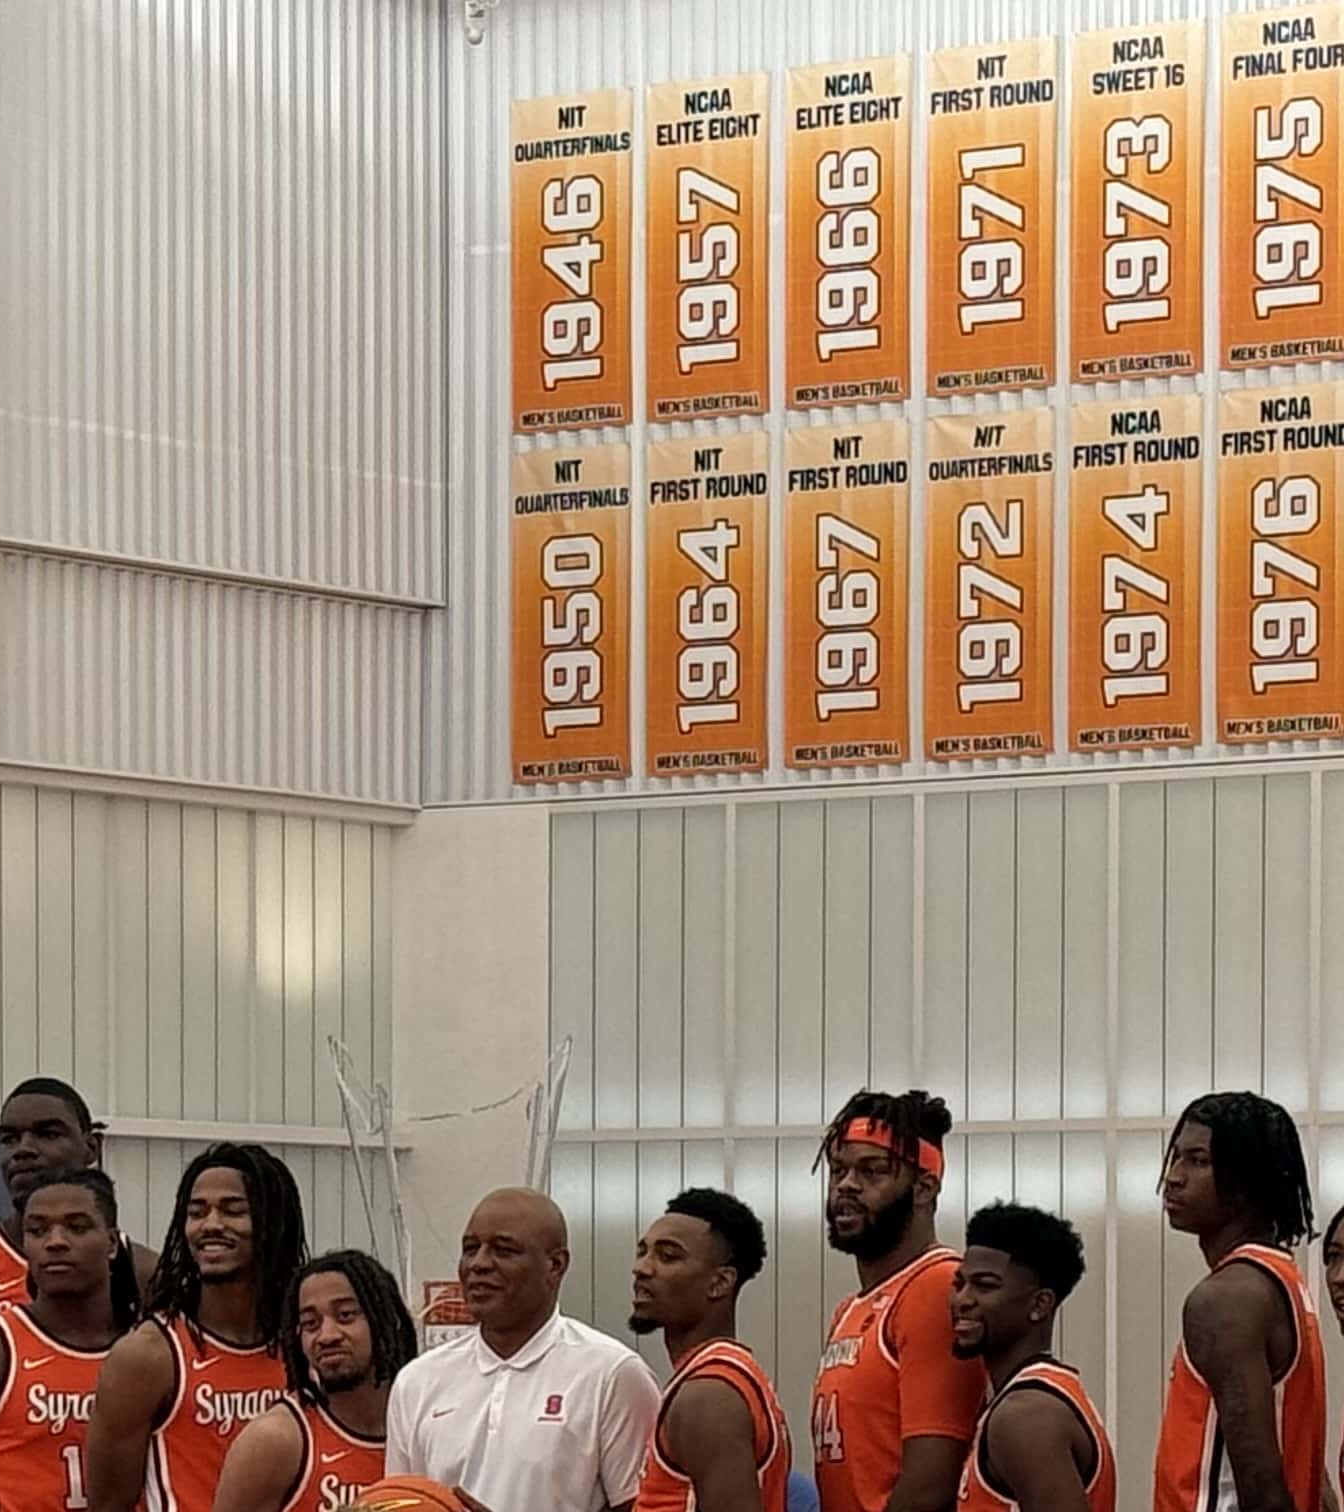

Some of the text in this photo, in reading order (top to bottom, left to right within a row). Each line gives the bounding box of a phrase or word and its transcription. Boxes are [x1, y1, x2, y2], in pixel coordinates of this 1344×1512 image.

[1262, 17, 1316, 46] NCAA
[1112, 36, 1165, 65] NCAA
[1232, 50, 1288, 80] FINAL
[977, 54, 1007, 80] NIT
[1091, 64, 1186, 95] SWEET 16
[683, 88, 732, 114] NCAA
[823, 72, 873, 99] NCAA
[930, 79, 1055, 115] FIRST ROUND
[558, 105, 587, 130] NIT
[656, 113, 761, 147] ELITE EIGHT
[796, 98, 902, 131] ELITE EIGHT
[514, 131, 632, 163] QUARTERFINALS
[1103, 113, 1172, 334] 1973
[1254, 97, 1323, 320] 1975
[816, 146, 881, 363] 1966
[958, 142, 1025, 336] 1971
[541, 173, 604, 391] 1946
[676, 167, 740, 375] 1957
[1110, 410, 1162, 437] NCAA
[1260, 396, 1312, 424] NCAA
[833, 436, 863, 461] NIT
[973, 425, 1006, 449] NIT
[1073, 434, 1200, 471] FIRST ROUND
[1221, 428, 1280, 457] FIRST
[555, 460, 583, 485] NIT
[694, 448, 723, 473] NIT
[788, 460, 909, 493] FIRST ROUND
[928, 452, 1054, 482] QUARTERFINALS
[514, 486, 630, 515] QUARTERFINALS
[650, 472, 767, 503] FIRST ROUND
[1101, 484, 1170, 708] 1974
[1250, 474, 1322, 695] 1976
[816, 512, 880, 723] 1967
[957, 499, 1024, 713] 1972
[541, 533, 604, 738] 1950
[676, 518, 740, 734] 1964
[27, 1383, 97, 1434] Syra
[61, 1445, 88, 1510] 1
